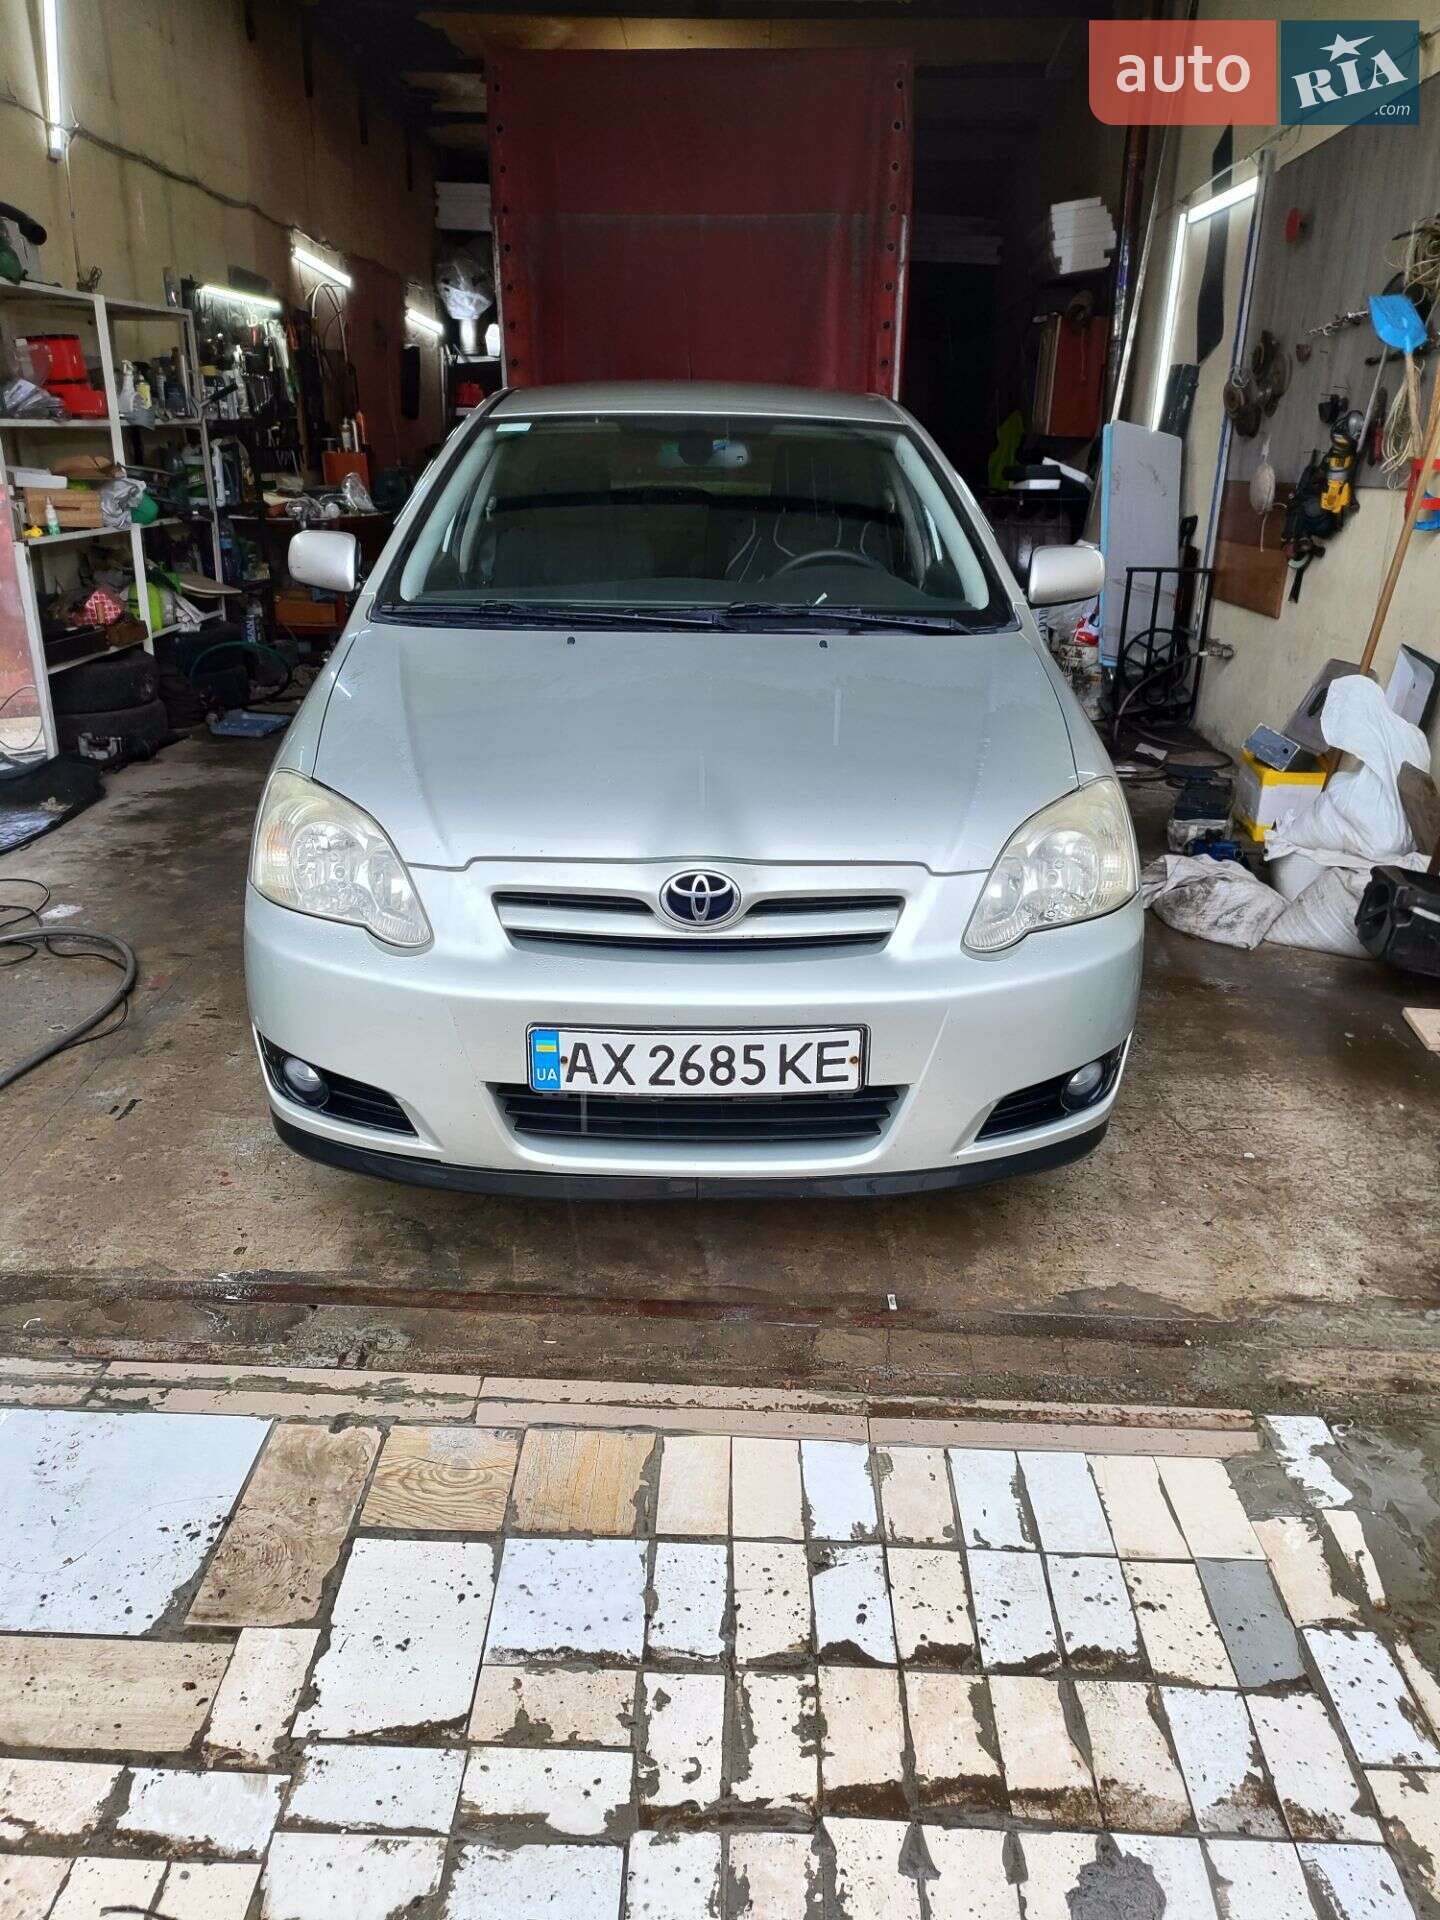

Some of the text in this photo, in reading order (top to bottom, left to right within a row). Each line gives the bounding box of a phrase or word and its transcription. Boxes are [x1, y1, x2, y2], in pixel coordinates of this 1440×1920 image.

[536, 1068, 558, 1082] UA
[565, 1040, 850, 1086] AX 2685 KE
